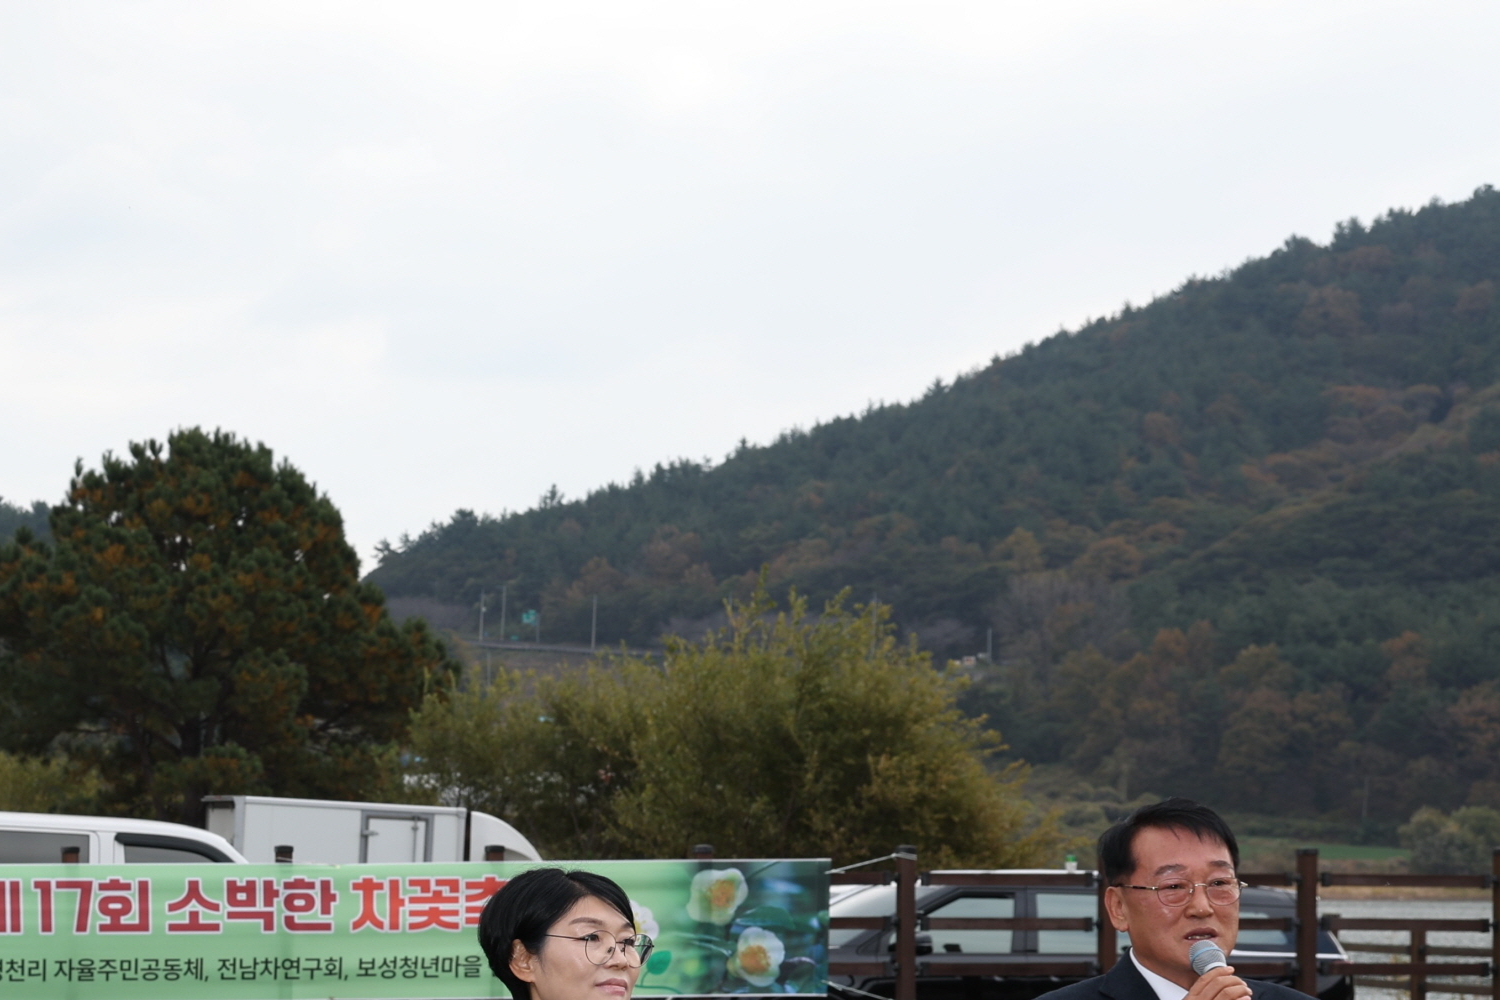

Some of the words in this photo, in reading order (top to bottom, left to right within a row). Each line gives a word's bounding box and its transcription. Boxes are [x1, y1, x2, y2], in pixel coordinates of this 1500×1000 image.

[167, 877, 338, 933] 소박한
[54, 957, 209, 982] 자율주민공동체,
[217, 956, 349, 981] 전남차연구회,
[356, 955, 482, 979] 보성청년마을
